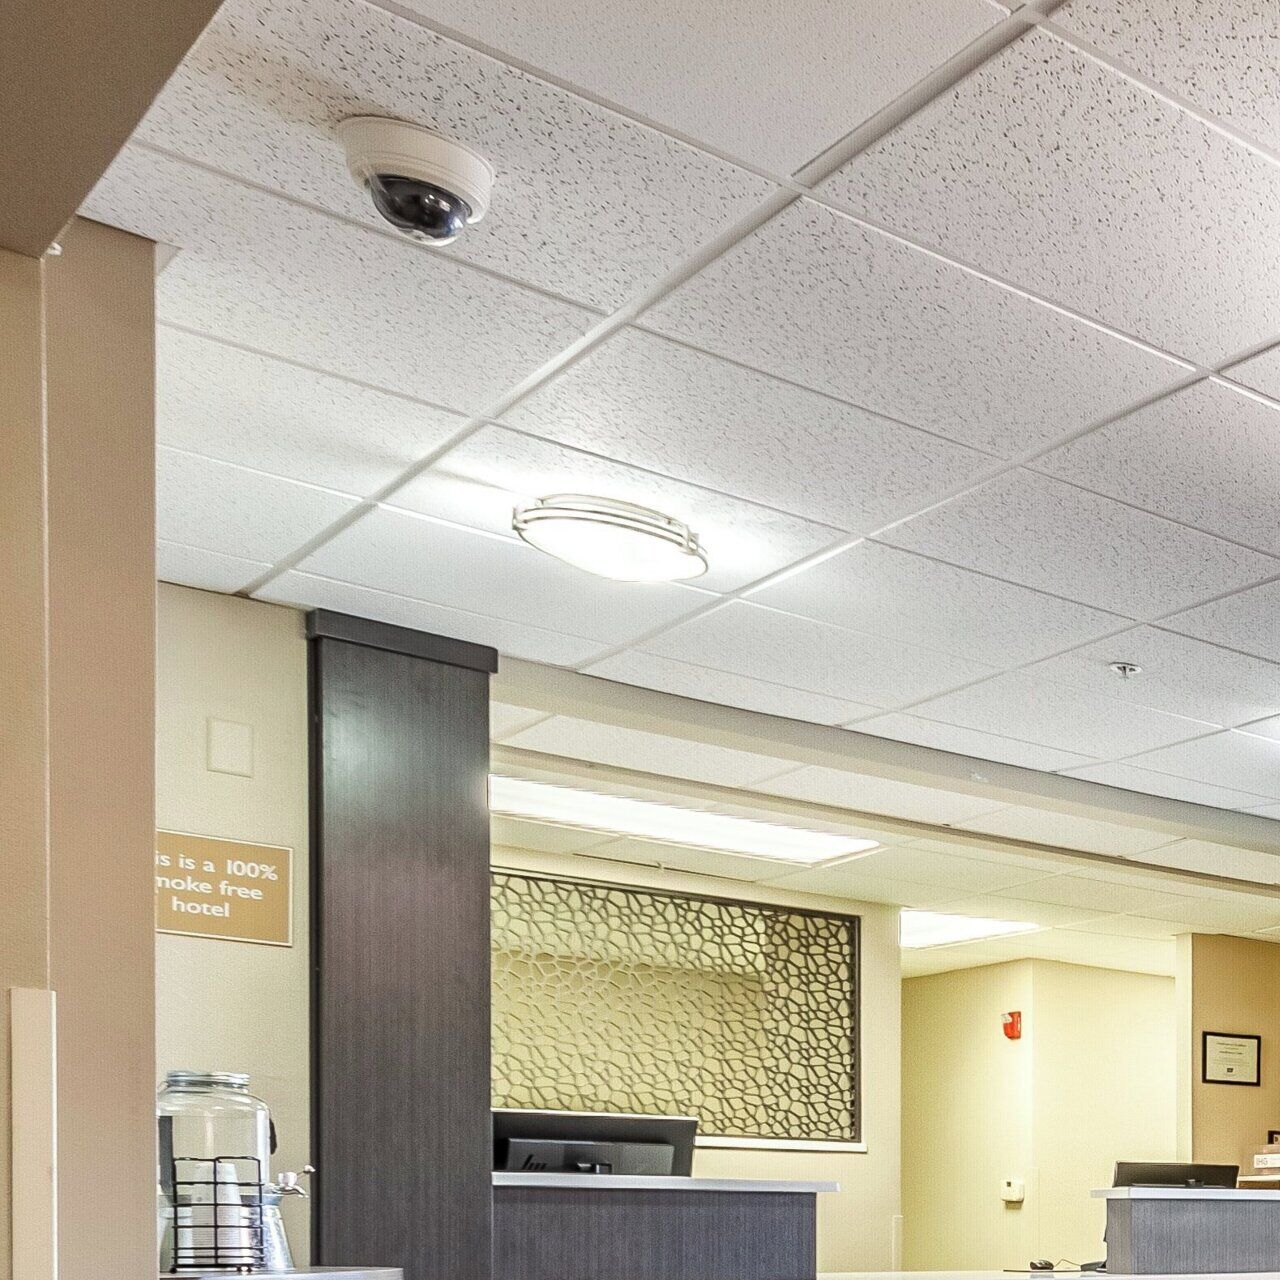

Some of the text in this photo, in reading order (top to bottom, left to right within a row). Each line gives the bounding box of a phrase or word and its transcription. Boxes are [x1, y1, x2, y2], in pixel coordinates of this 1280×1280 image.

[155, 850, 279, 881] is is a 100%
[155, 875, 264, 900] moke free
[171, 896, 230, 918] hotel
